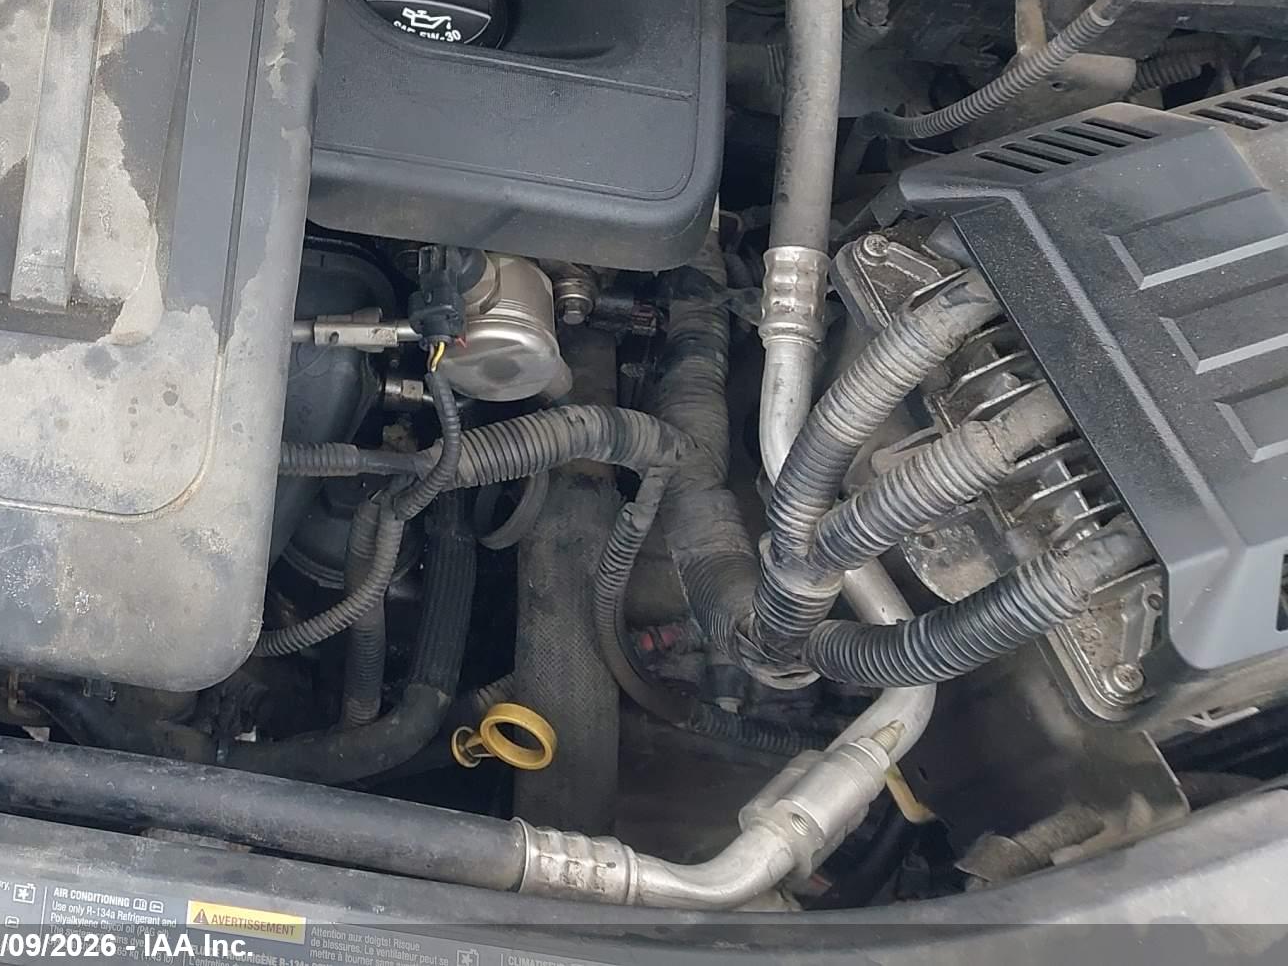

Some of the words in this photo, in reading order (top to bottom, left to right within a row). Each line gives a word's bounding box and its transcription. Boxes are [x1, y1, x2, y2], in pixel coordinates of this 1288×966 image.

[53, 887, 68, 898] AIR
[70, 889, 130, 907] CONDITIONING
[52, 900, 66, 911] Use
[68, 904, 85, 916] only
[86, 906, 115, 919] R-134a
[117, 910, 161, 926] Refrigerant
[161, 917, 177, 928] and
[212, 914, 296, 936] AVERTISSEMENT
[100, 919, 124, 932] Glycol
[125, 923, 135, 934] oil
[311, 926, 346, 940] Attention
[348, 933, 362, 943] aux
[393, 938, 420, 952] Risque
[310, 937, 320, 947] de
[364, 945, 374, 955] Le
[376, 946, 418, 962] ventilateur
[420, 954, 437, 966] peut
[310, 948, 336, 960] mettre
[345, 952, 373, 966] tourner
